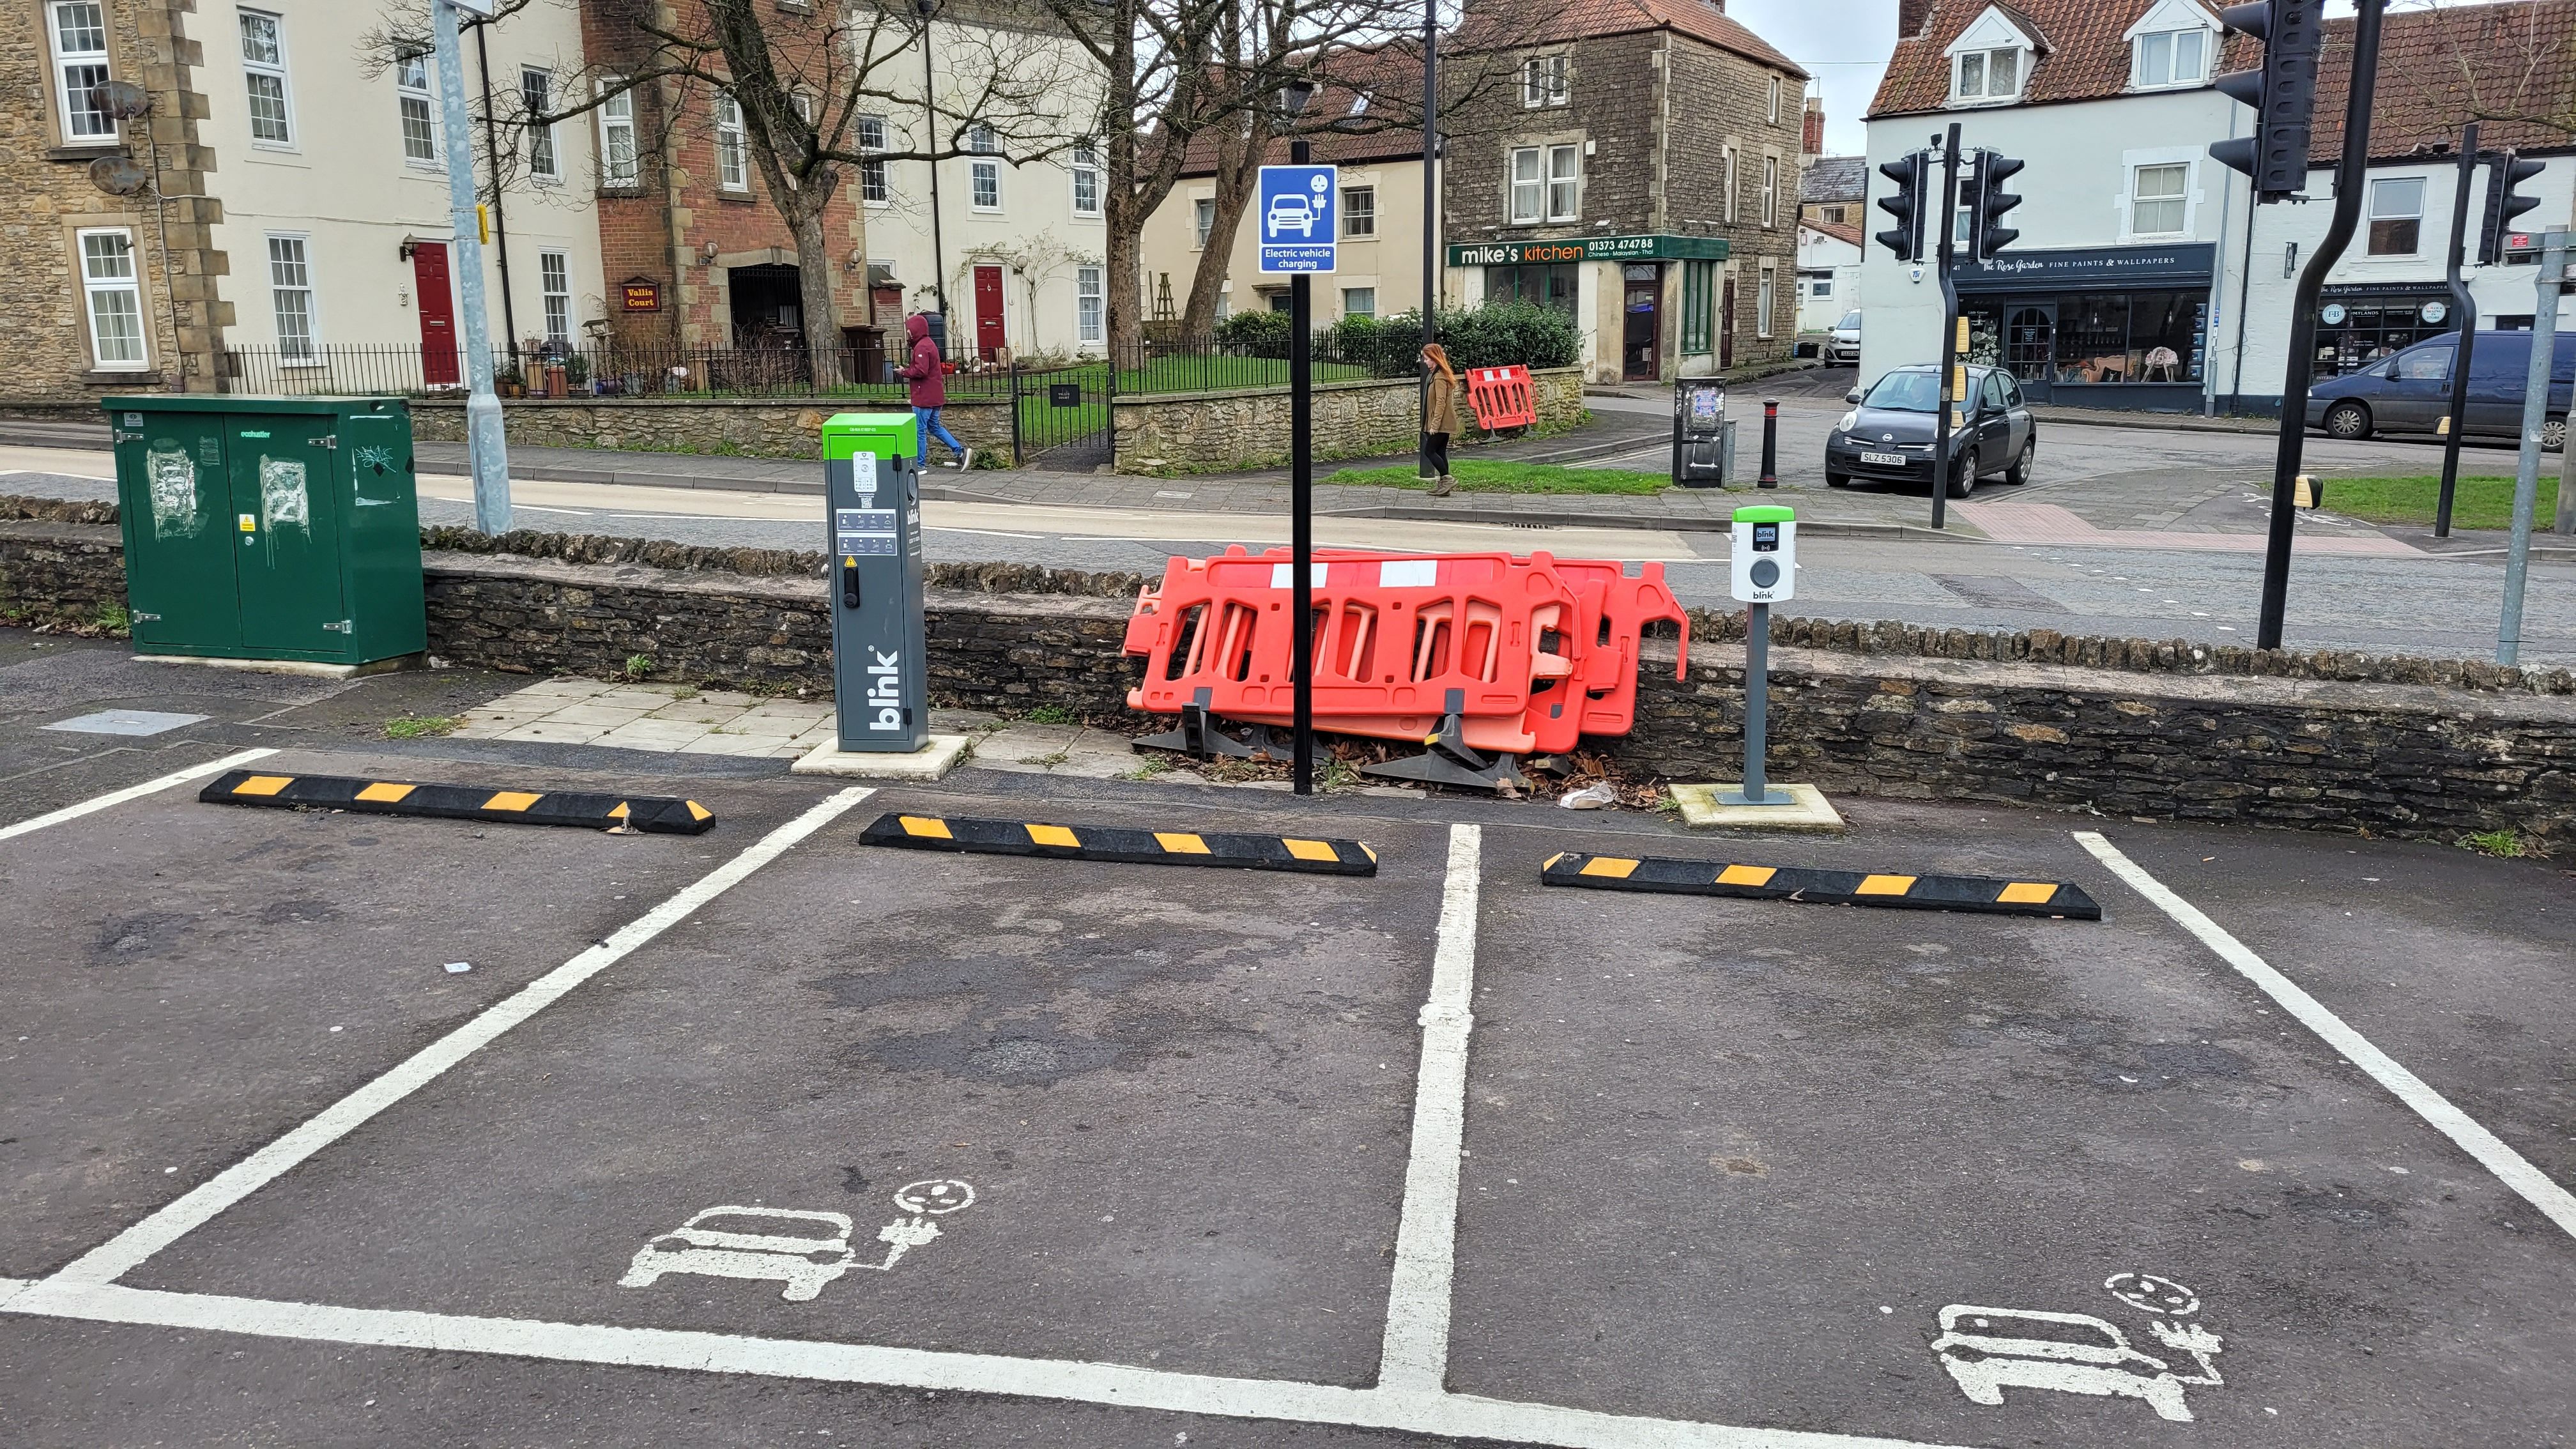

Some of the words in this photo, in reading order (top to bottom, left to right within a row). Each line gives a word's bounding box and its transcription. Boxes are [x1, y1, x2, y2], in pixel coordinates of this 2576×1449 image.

[1589, 241, 1615, 250] 01373
[1618, 239, 1653, 249] 474788
[1265, 249, 1298, 257] Electric
[1300, 249, 1330, 257] vehicle
[1462, 245, 1518, 263] mike's
[1524, 244, 1584, 261] kitchen
[1278, 259, 1317, 270] charging
[1996, 260, 2014, 272] Rose
[2016, 259, 2043, 273] Garden
[2343, 285, 2363, 294] Garden
[1864, 454, 1879, 462] SLZ
[1882, 455, 1903, 464] 5306
